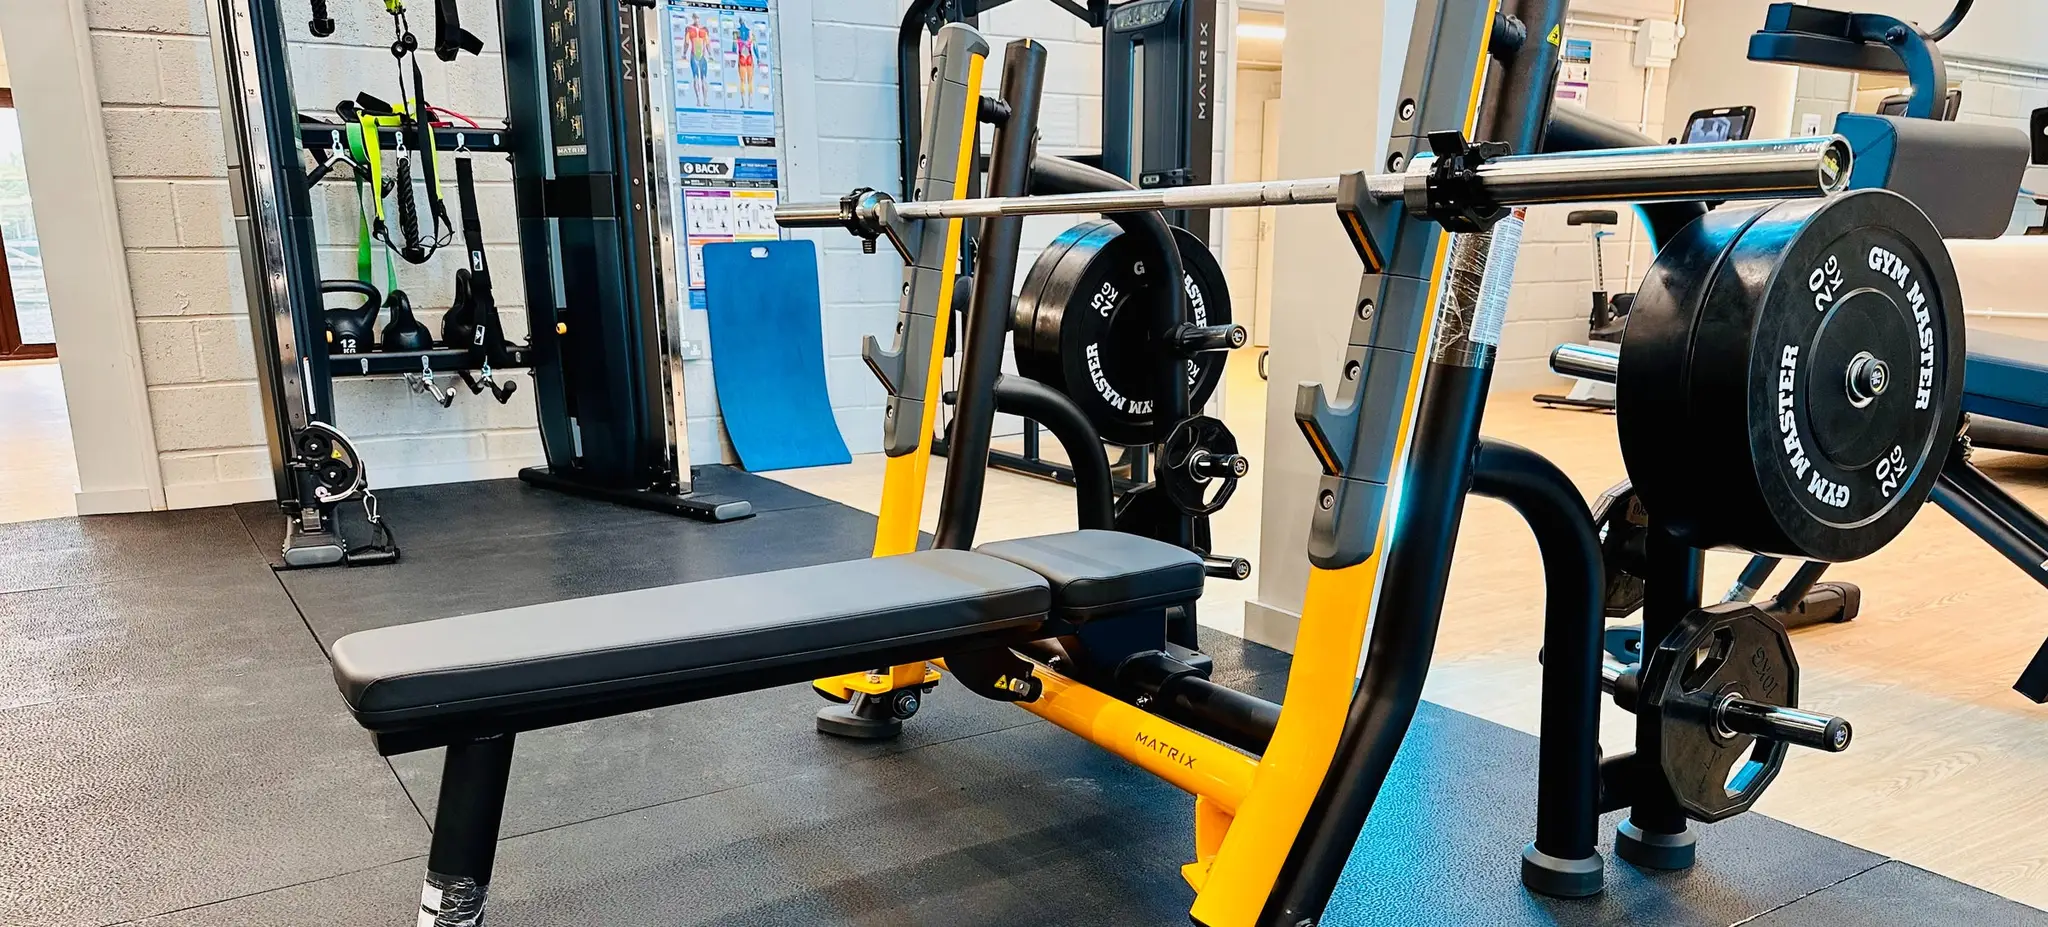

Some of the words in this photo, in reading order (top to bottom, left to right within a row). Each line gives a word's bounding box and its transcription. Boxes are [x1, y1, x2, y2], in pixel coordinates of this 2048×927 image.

[1198, 22, 1208, 119] MATRIX
[695, 163, 720, 174] BACK
[1101, 282, 1119, 298] KG
[1808, 267, 1833, 311] 20
[1824, 255, 1844, 292] KG
[1091, 293, 1114, 317] 25
[1183, 269, 1207, 329] ASTE
[340, 338, 356, 348] 12
[1868, 246, 1910, 289] GYM
[1906, 281, 1935, 410] MASTER
[1086, 342, 1127, 411] MASTER
[1128, 400, 1153, 415] YM
[1778, 345, 1811, 480] MASTER
[1876, 458, 1898, 497] 20
[1891, 445, 1908, 479] KG
[1807, 471, 1850, 508] GYM
[1752, 646, 1778, 699] 10KG
[1135, 731, 1197, 769] MATRIX
